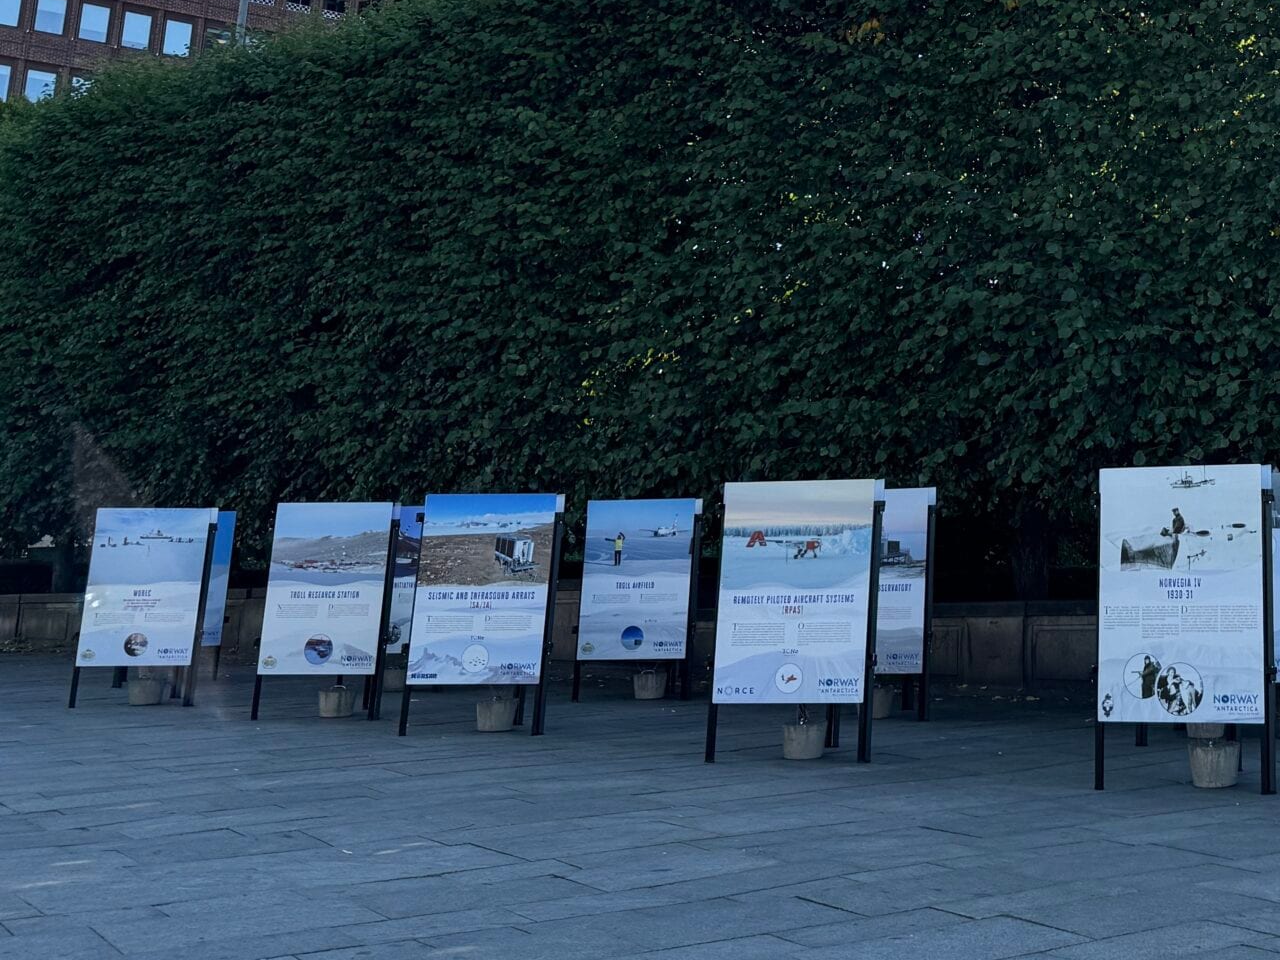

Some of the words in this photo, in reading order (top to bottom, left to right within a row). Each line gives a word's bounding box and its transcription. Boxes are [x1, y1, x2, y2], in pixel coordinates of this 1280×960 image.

[1159, 577, 1191, 588] NORVEGIA
[290, 591, 306, 599] TROLL
[308, 591, 335, 599] RESEARCH
[337, 590, 360, 599] STATION
[427, 591, 454, 600] SEISMIC
[455, 591, 468, 600] AND
[470, 591, 510, 600] INFRASOUND
[511, 591, 536, 600] ARRAYS
[733, 595, 764, 604] REMOTELY
[766, 595, 791, 604] PILOTED
[793, 594, 823, 604] AIRCRAFT
[825, 594, 855, 603] SYSTEMS
[500, 662, 537, 670] NORWAY
[818, 678, 859, 687] NORWAY
[717, 686, 755, 695] NORCE
[1213, 693, 1259, 705] NORWAY
